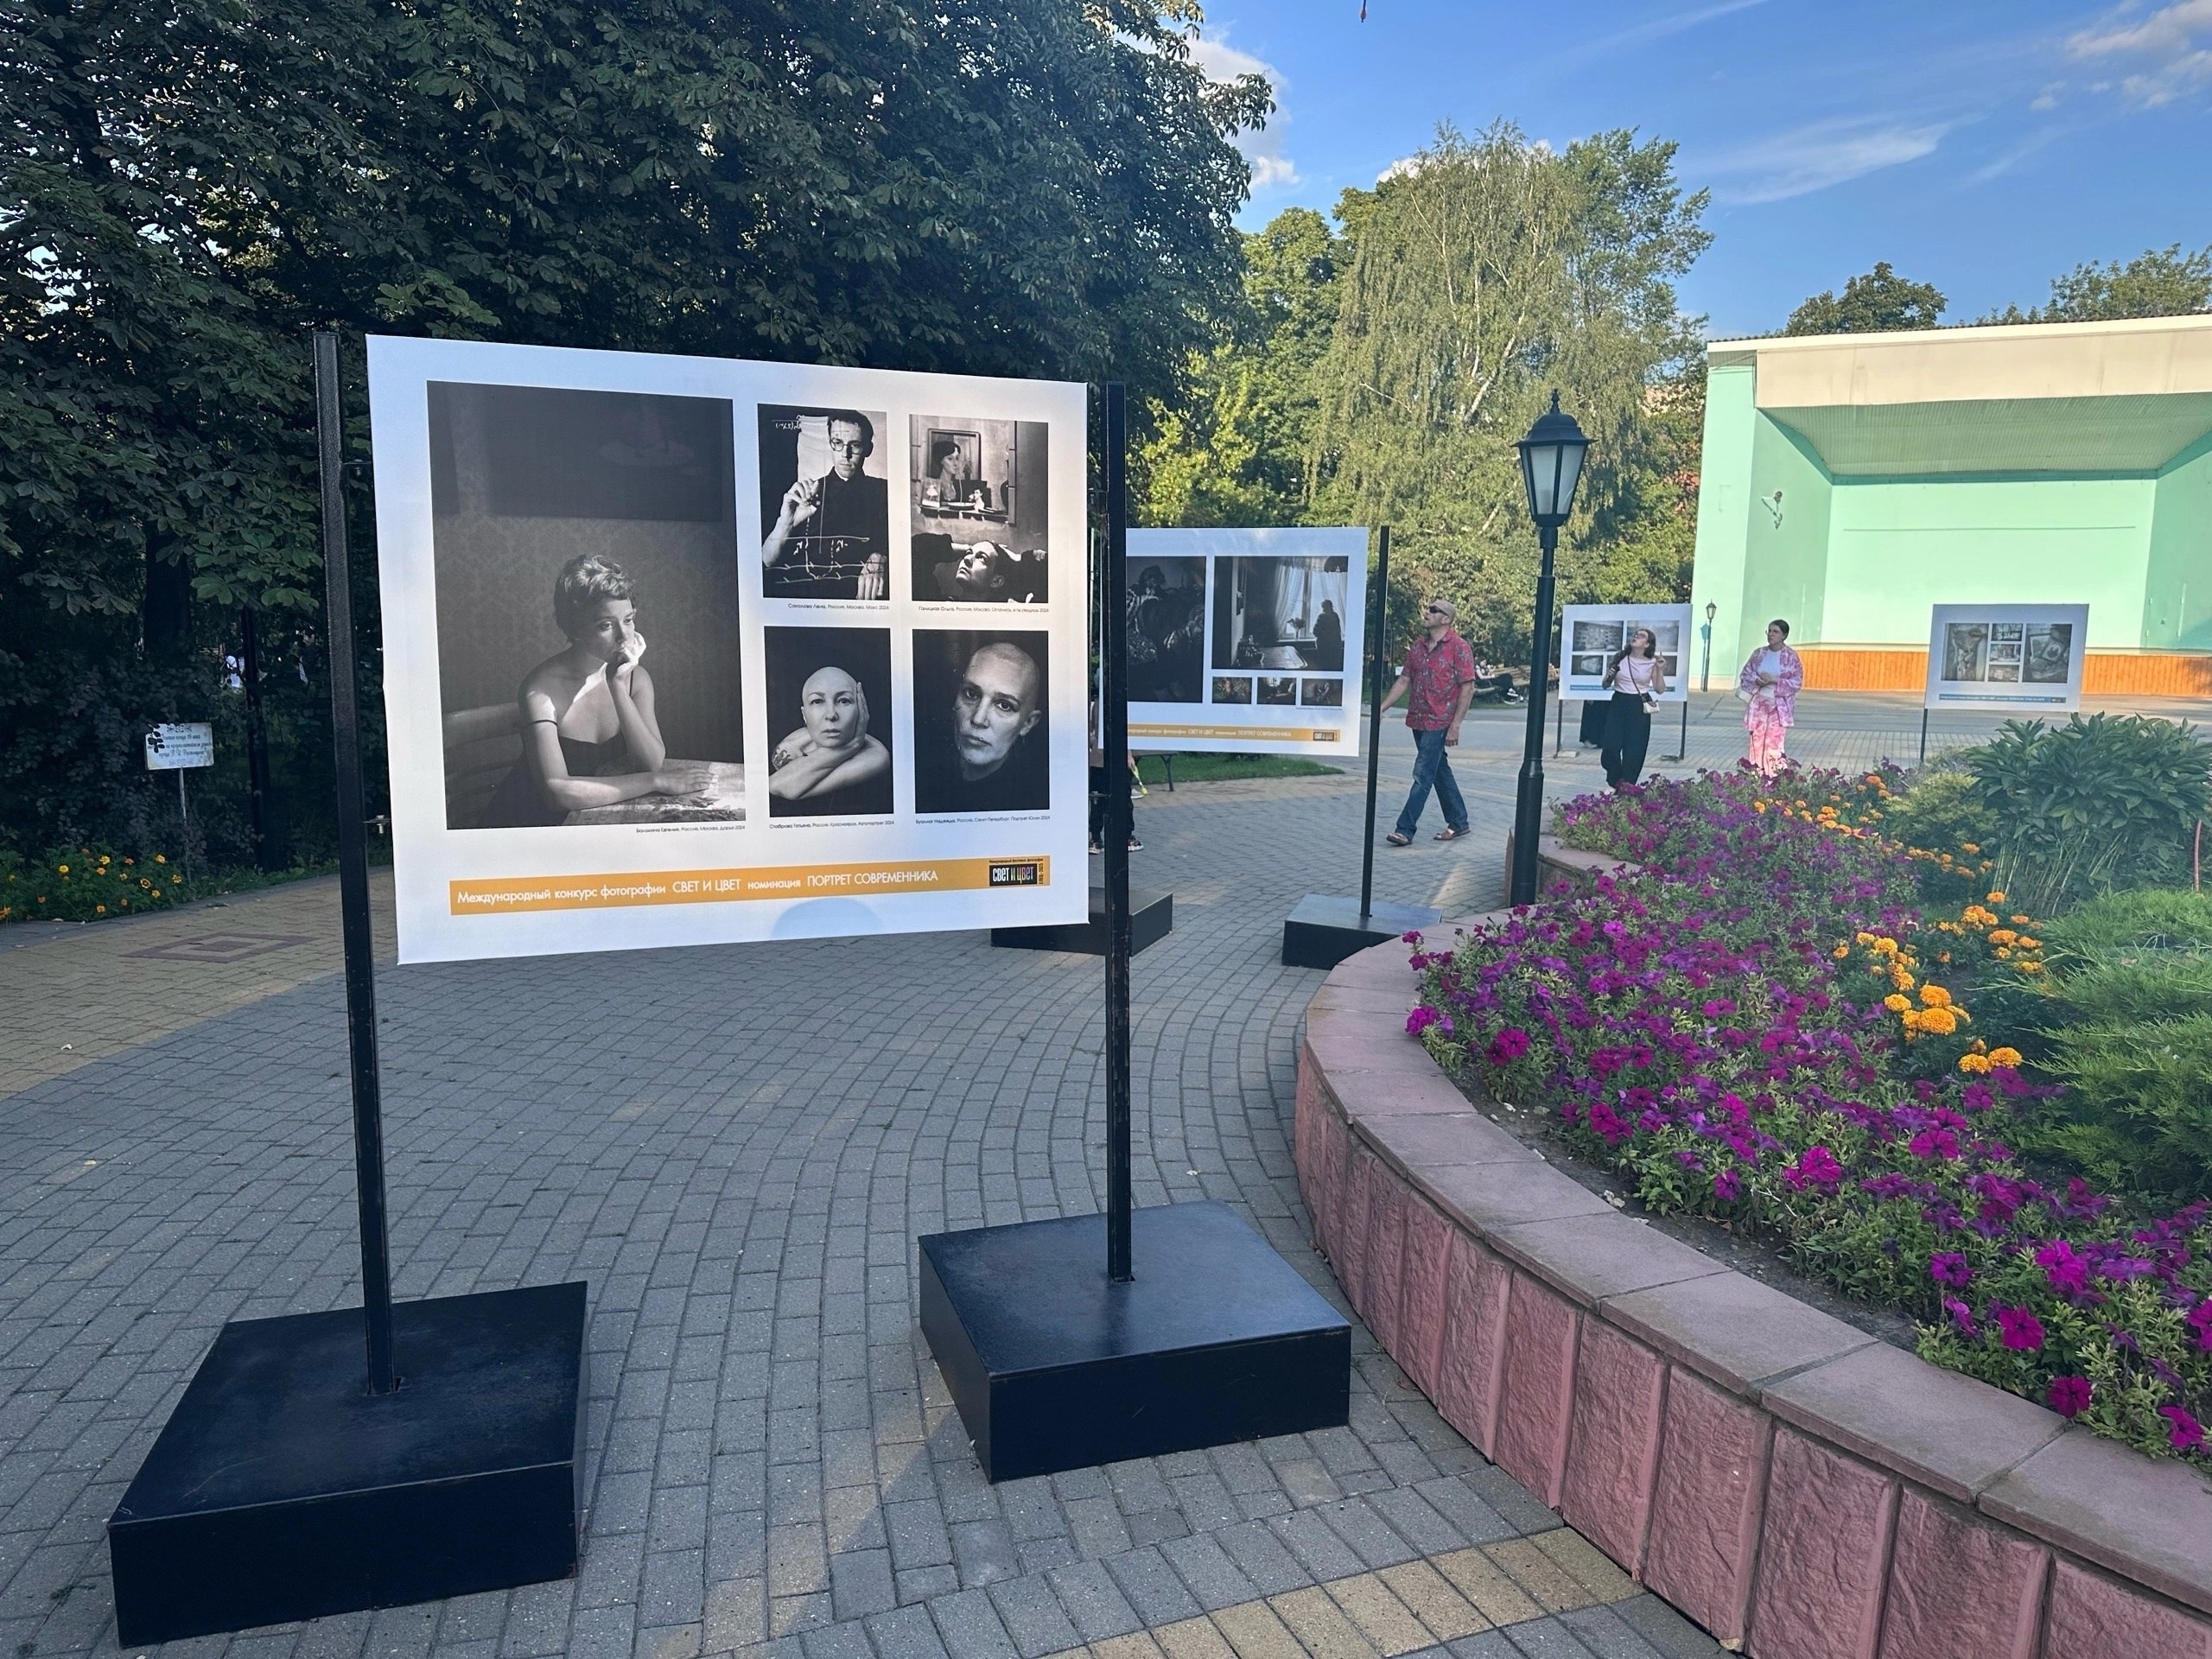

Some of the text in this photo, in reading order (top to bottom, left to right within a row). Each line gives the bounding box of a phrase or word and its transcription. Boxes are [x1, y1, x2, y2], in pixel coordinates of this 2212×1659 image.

[457, 869, 938, 905] Международный конкурс фотографии СВЕТ И ЦВЕТ номинация ПОРТРЕТ СОВРЕМЕННИКА
